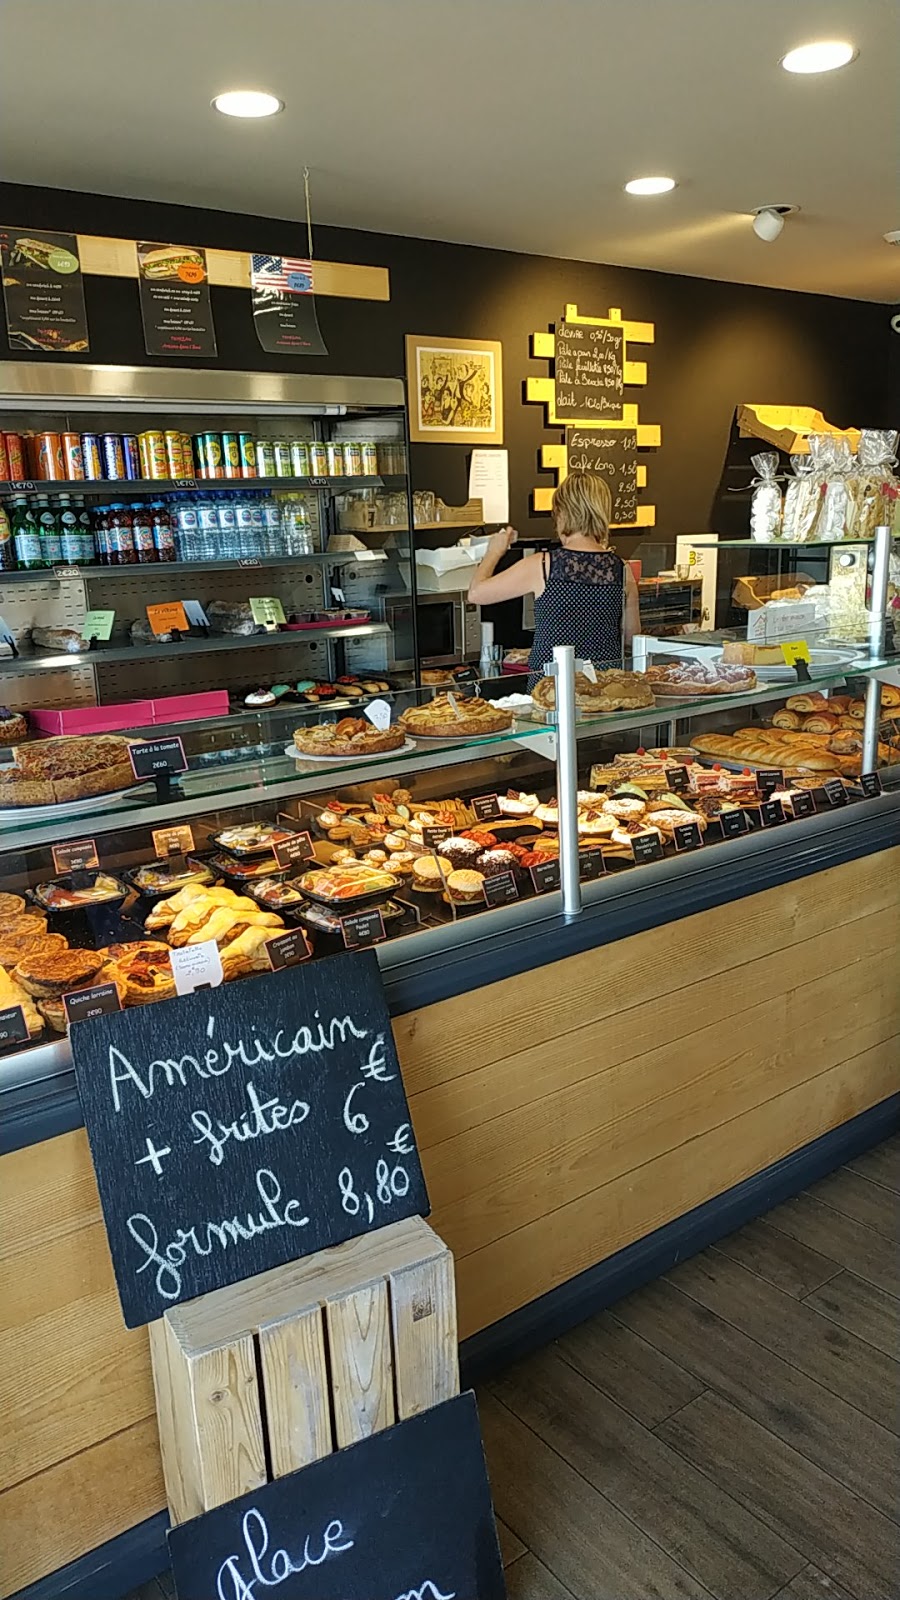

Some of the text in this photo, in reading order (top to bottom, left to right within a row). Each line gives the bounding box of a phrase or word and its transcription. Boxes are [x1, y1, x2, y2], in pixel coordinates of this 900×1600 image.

[571, 433, 617, 449] Espresso
[569, 453, 594, 474] Café
[57, 569, 79, 577] 2€20
[152, 760, 168, 769] 2€60
[69, 989, 114, 1005] Quiche lorraine
[87, 1008, 103, 1017] 2€90
[109, 1011, 368, 1113] Américain
[192, 1082, 310, 1166] frites
[126, 1158, 410, 1300] formule 8,80
